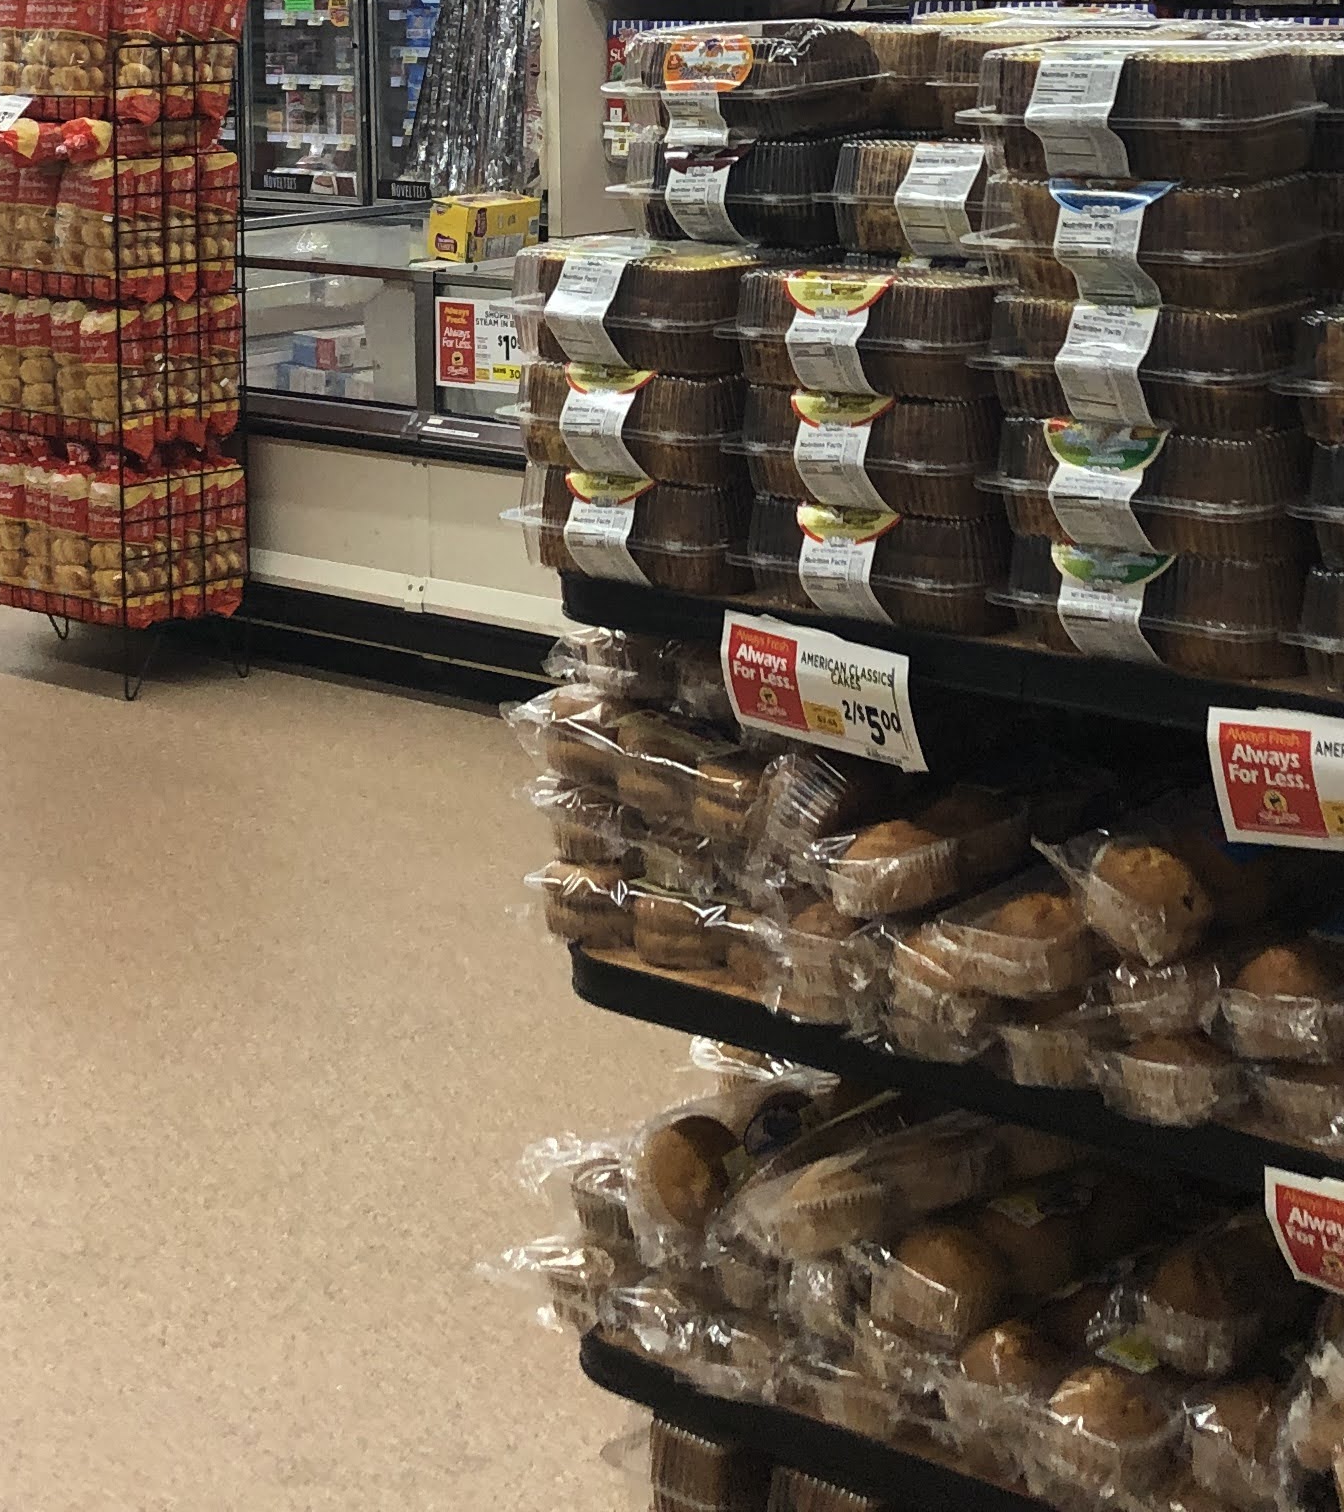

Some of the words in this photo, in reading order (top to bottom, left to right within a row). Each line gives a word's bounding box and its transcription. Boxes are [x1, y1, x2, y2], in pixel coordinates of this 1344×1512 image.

[444, 327, 471, 342] Always
[476, 318, 499, 327] STEAM
[442, 338, 455, 348] For
[456, 339, 472, 349] Less.
[498, 335, 521, 361] $10
[736, 643, 788, 672] Always
[801, 651, 847, 677] AMERICAN
[849, 663, 894, 688] CLASSICS
[733, 660, 756, 680] For
[760, 668, 795, 691] Less.
[830, 671, 862, 692] CAKES
[1232, 743, 1300, 771] Always
[1228, 763, 1259, 785] For
[1264, 767, 1311, 791] Less.
[1285, 1222, 1316, 1248] For
